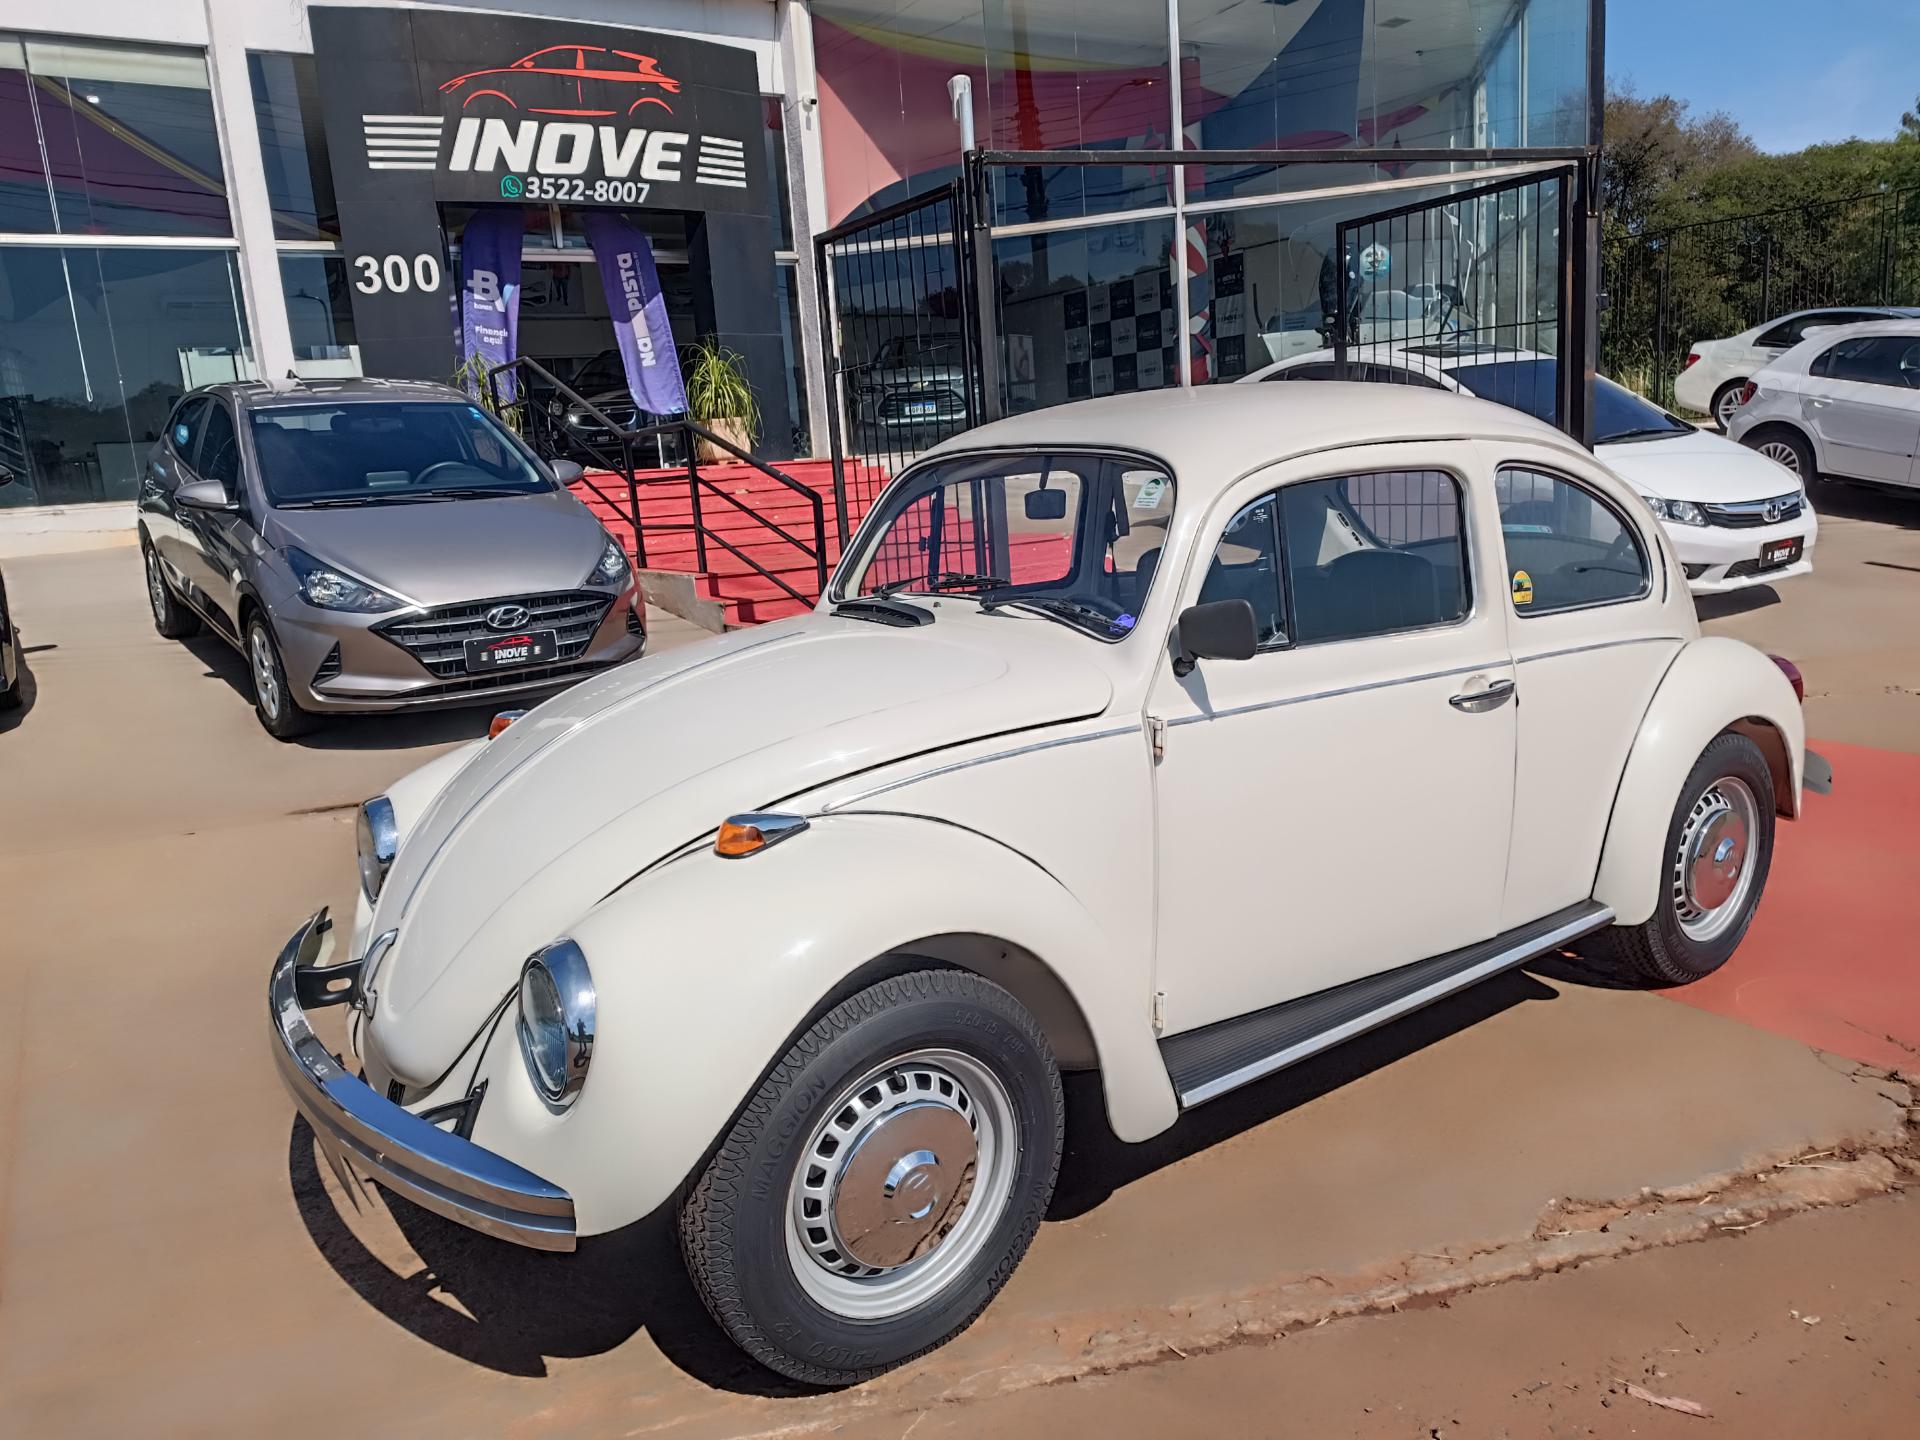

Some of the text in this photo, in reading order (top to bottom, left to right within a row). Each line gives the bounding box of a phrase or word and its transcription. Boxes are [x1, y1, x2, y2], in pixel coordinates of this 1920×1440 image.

[449, 117, 689, 182] INOVE
[525, 176, 650, 203] 3522-8007
[354, 253, 440, 294] 300
[494, 646, 528, 660] INOVE
[752, 1072, 826, 1201] MAGGION
[987, 1181, 1045, 1290] MAGGION
